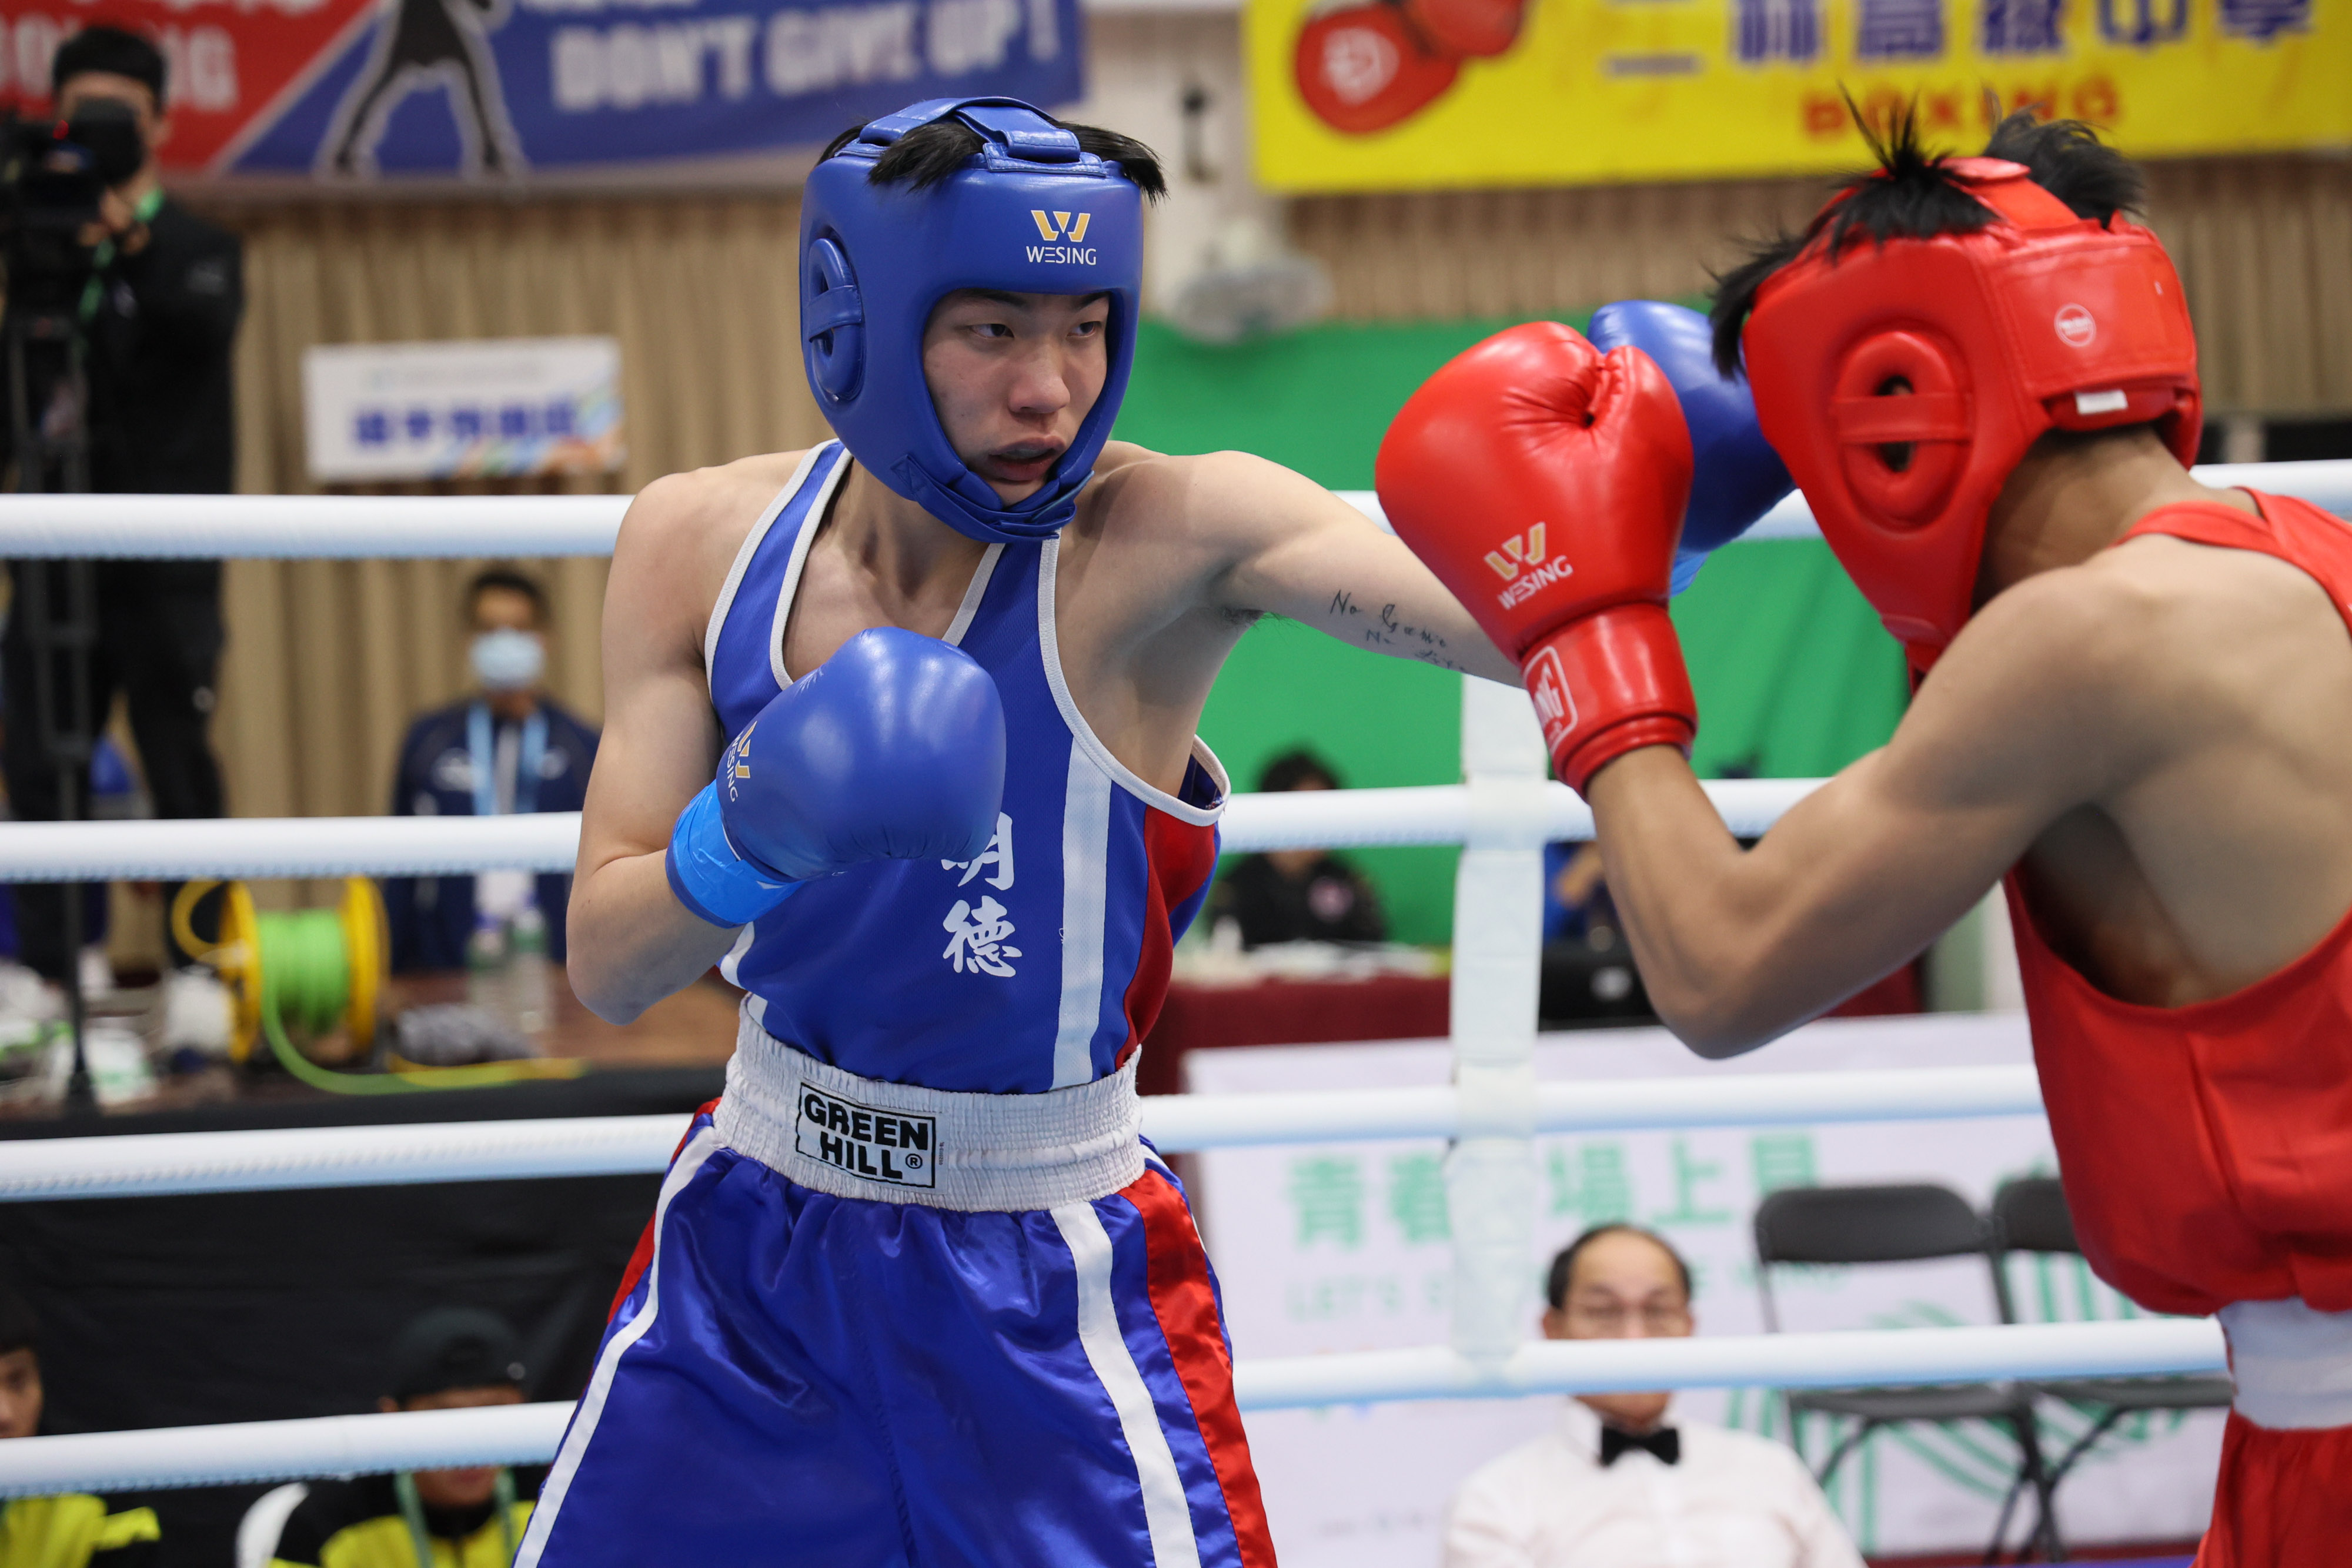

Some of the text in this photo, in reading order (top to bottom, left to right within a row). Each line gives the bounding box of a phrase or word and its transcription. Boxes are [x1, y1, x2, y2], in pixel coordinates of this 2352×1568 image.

[1025, 246, 1097, 266] WESING
[1498, 555, 1573, 610] WESING
[727, 731, 744, 803] WESING
[804, 1094, 928, 1151] GREEN
